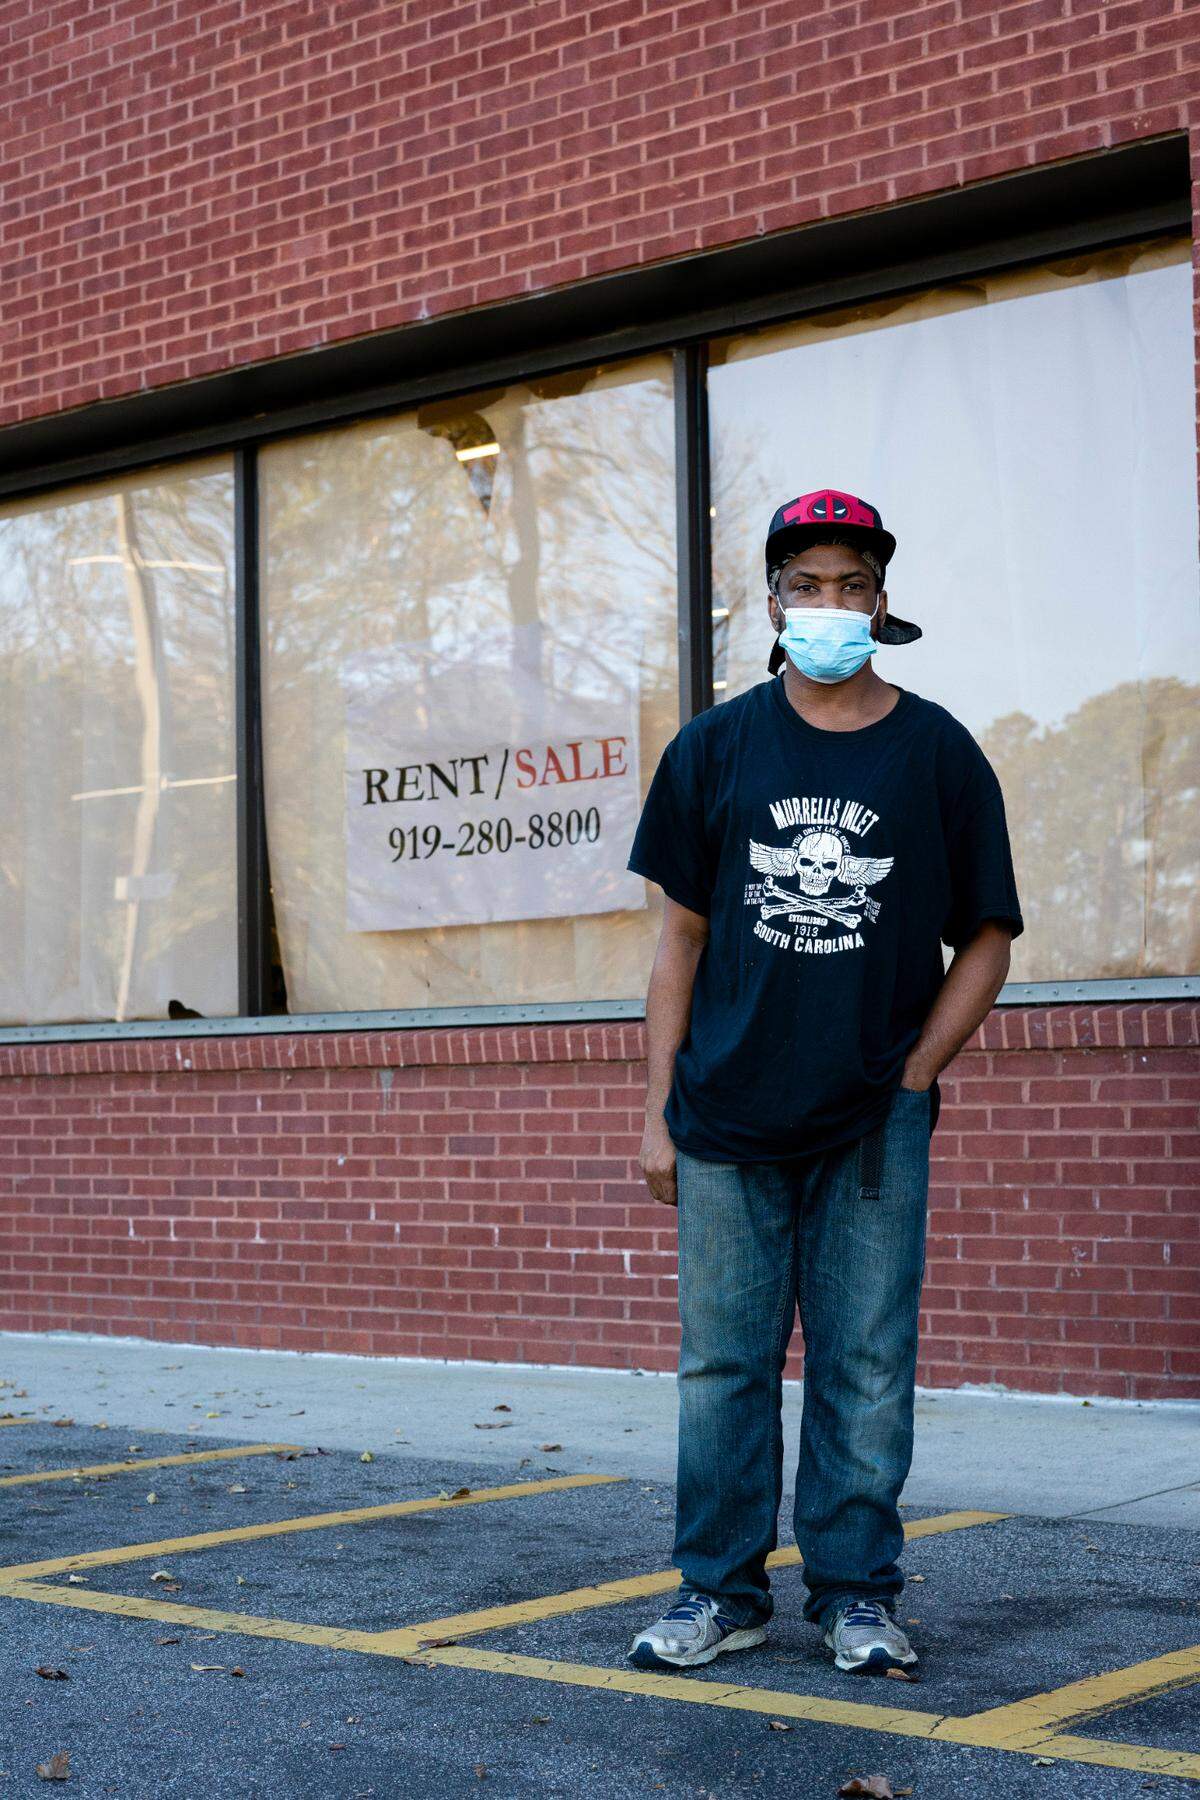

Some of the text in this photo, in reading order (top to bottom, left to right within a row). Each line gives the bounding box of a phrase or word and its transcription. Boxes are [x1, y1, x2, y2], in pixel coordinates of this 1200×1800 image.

[362, 737, 628, 806] RENT/SALE
[389, 807, 601, 863] 919-280-8800
[769, 797, 879, 837] MURRELLS INLET
[792, 825, 851, 855] YOU ONLY LIVE ONCE
[753, 920, 865, 954] SOUTH CAROLINA
